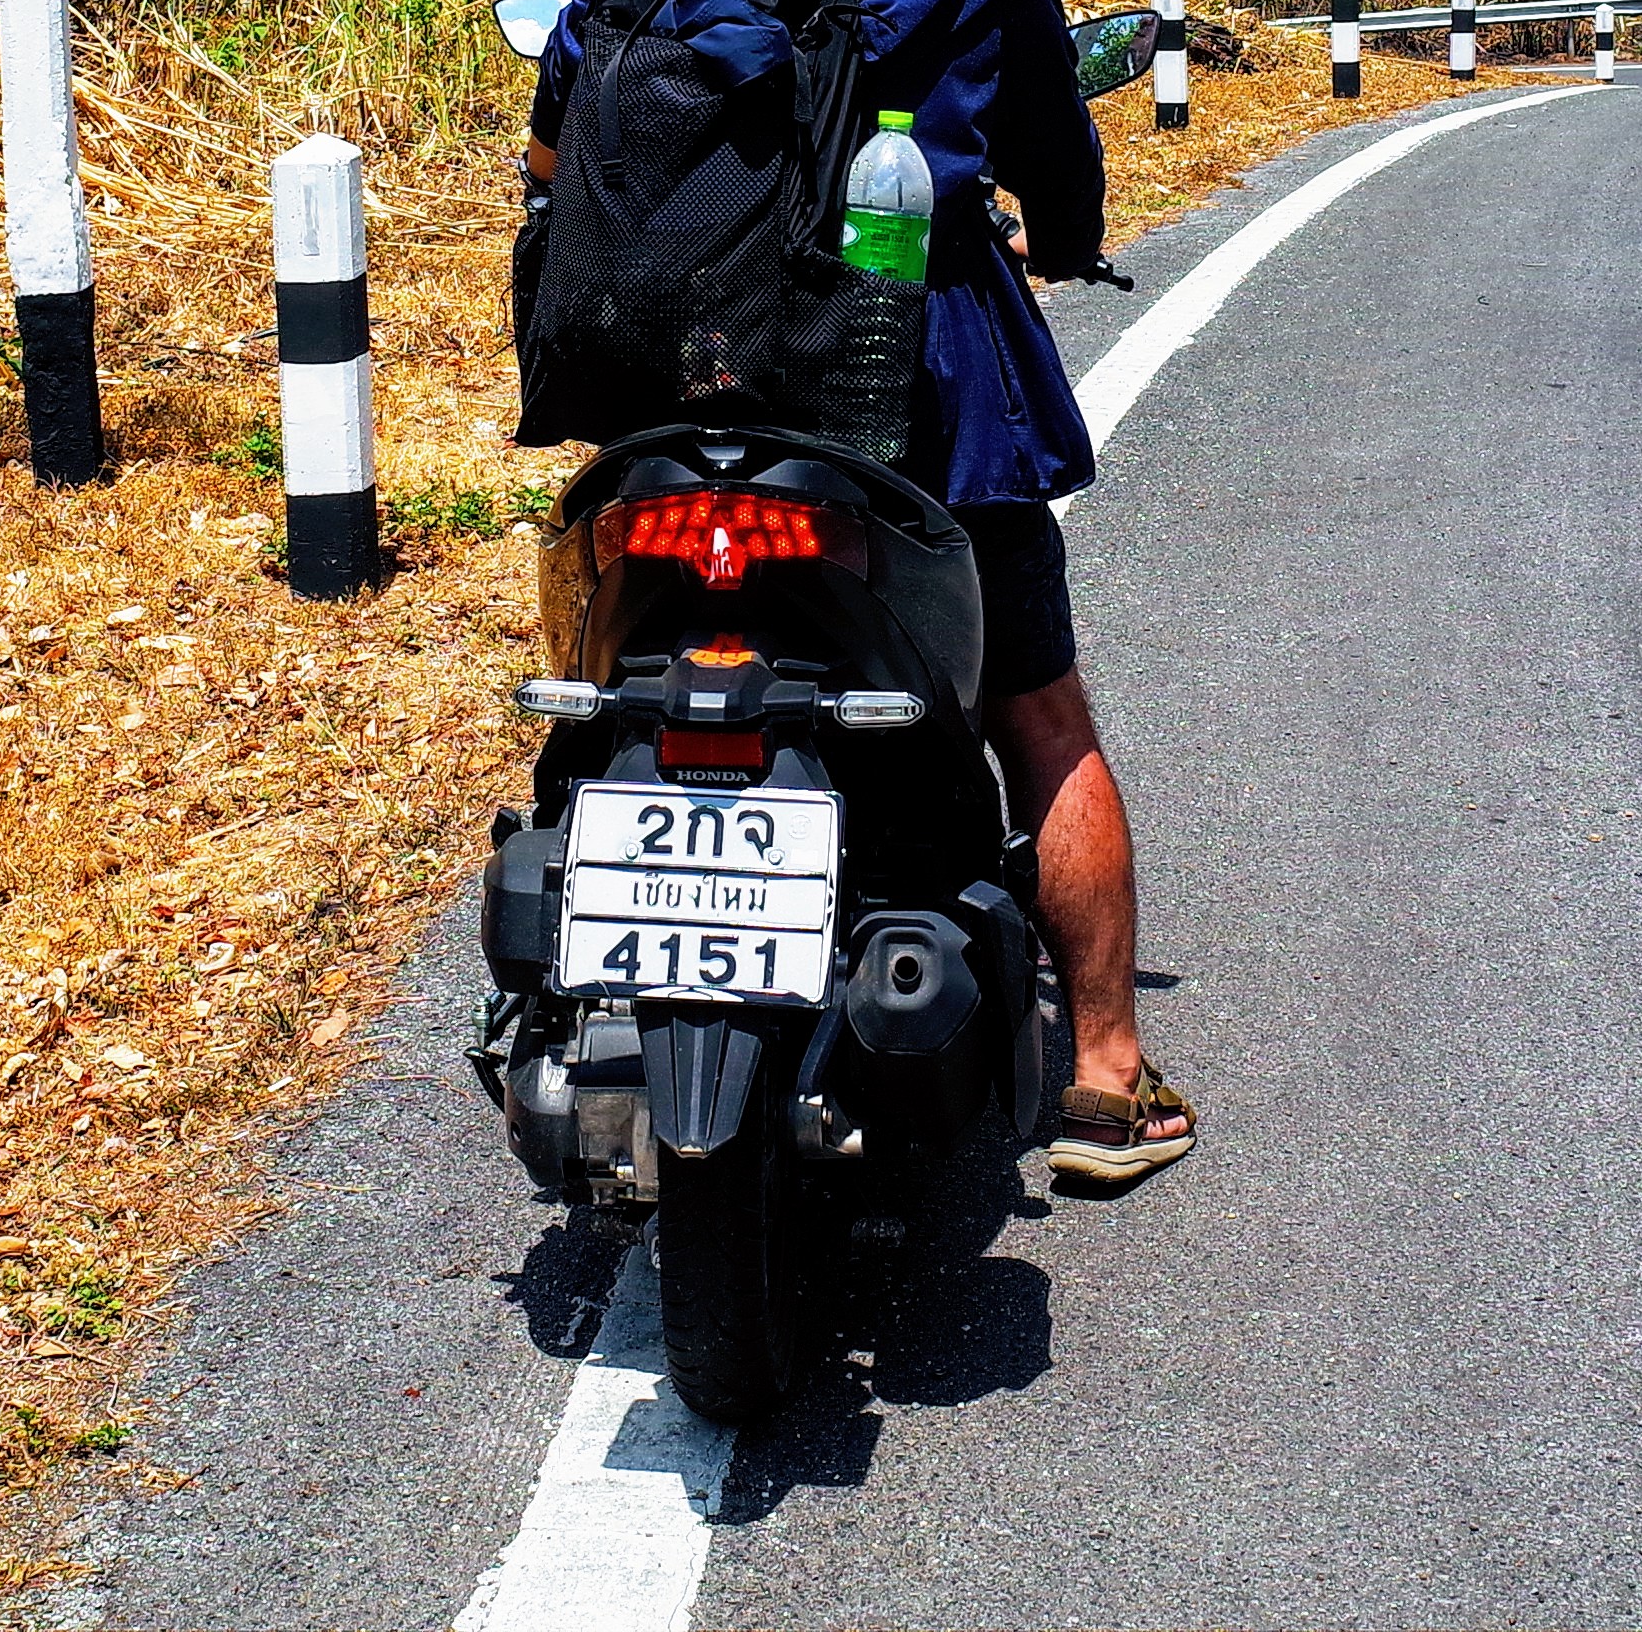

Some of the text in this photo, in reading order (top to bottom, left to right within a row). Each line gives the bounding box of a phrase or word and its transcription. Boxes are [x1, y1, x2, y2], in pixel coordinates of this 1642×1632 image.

[676, 769, 752, 782] HONDA
[637, 804, 775, 860] 2กจ
[632, 872, 767, 912] เชียงใหม่
[602, 930, 777, 989] 4151
